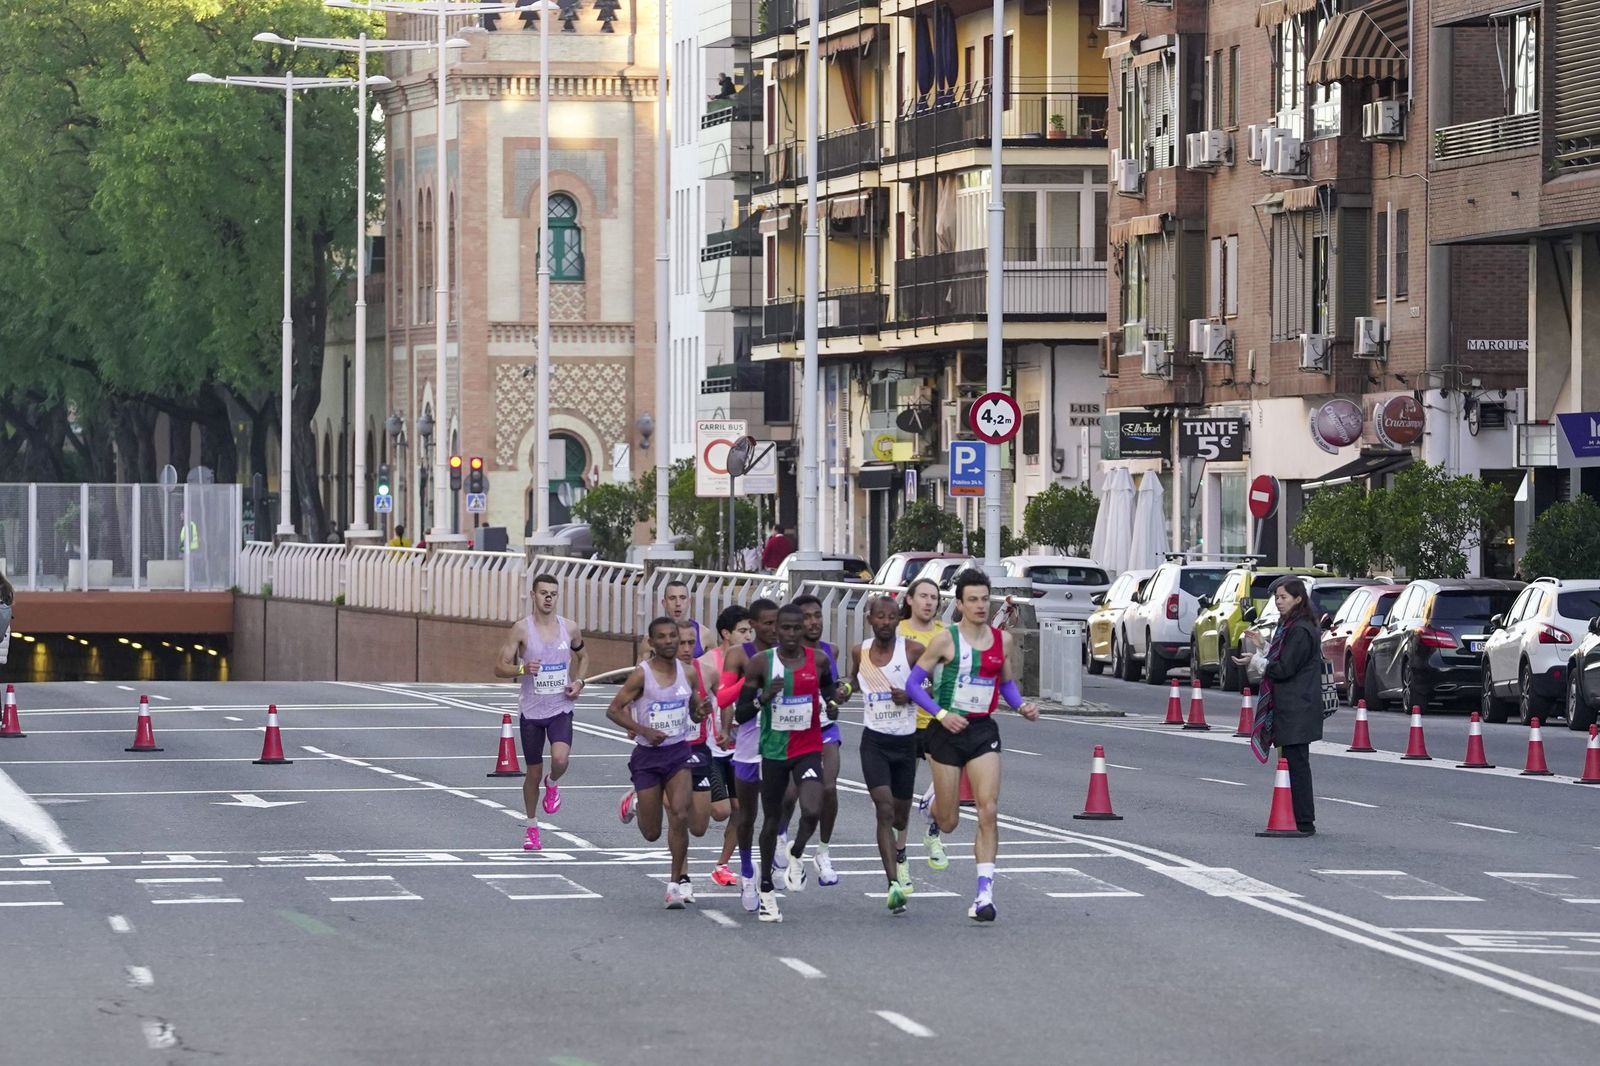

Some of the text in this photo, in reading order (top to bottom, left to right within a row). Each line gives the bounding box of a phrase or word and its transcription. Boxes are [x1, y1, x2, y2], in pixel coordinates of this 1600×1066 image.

[1070, 404, 1100, 413] LUIS
[699, 423, 744, 431] CARRIL BUS
[1324, 405, 1351, 443] Cruzcampo
[1384, 418, 1424, 428] Cruzcampo
[1182, 421, 1239, 436] TINTE
[1197, 436, 1232, 461] 5€
[955, 446, 977, 475] P
[536, 679, 565, 688] MATEUSZ
[970, 696, 979, 704] 49
[779, 715, 804, 723] PACER
[874, 712, 902, 720] LOTORY
